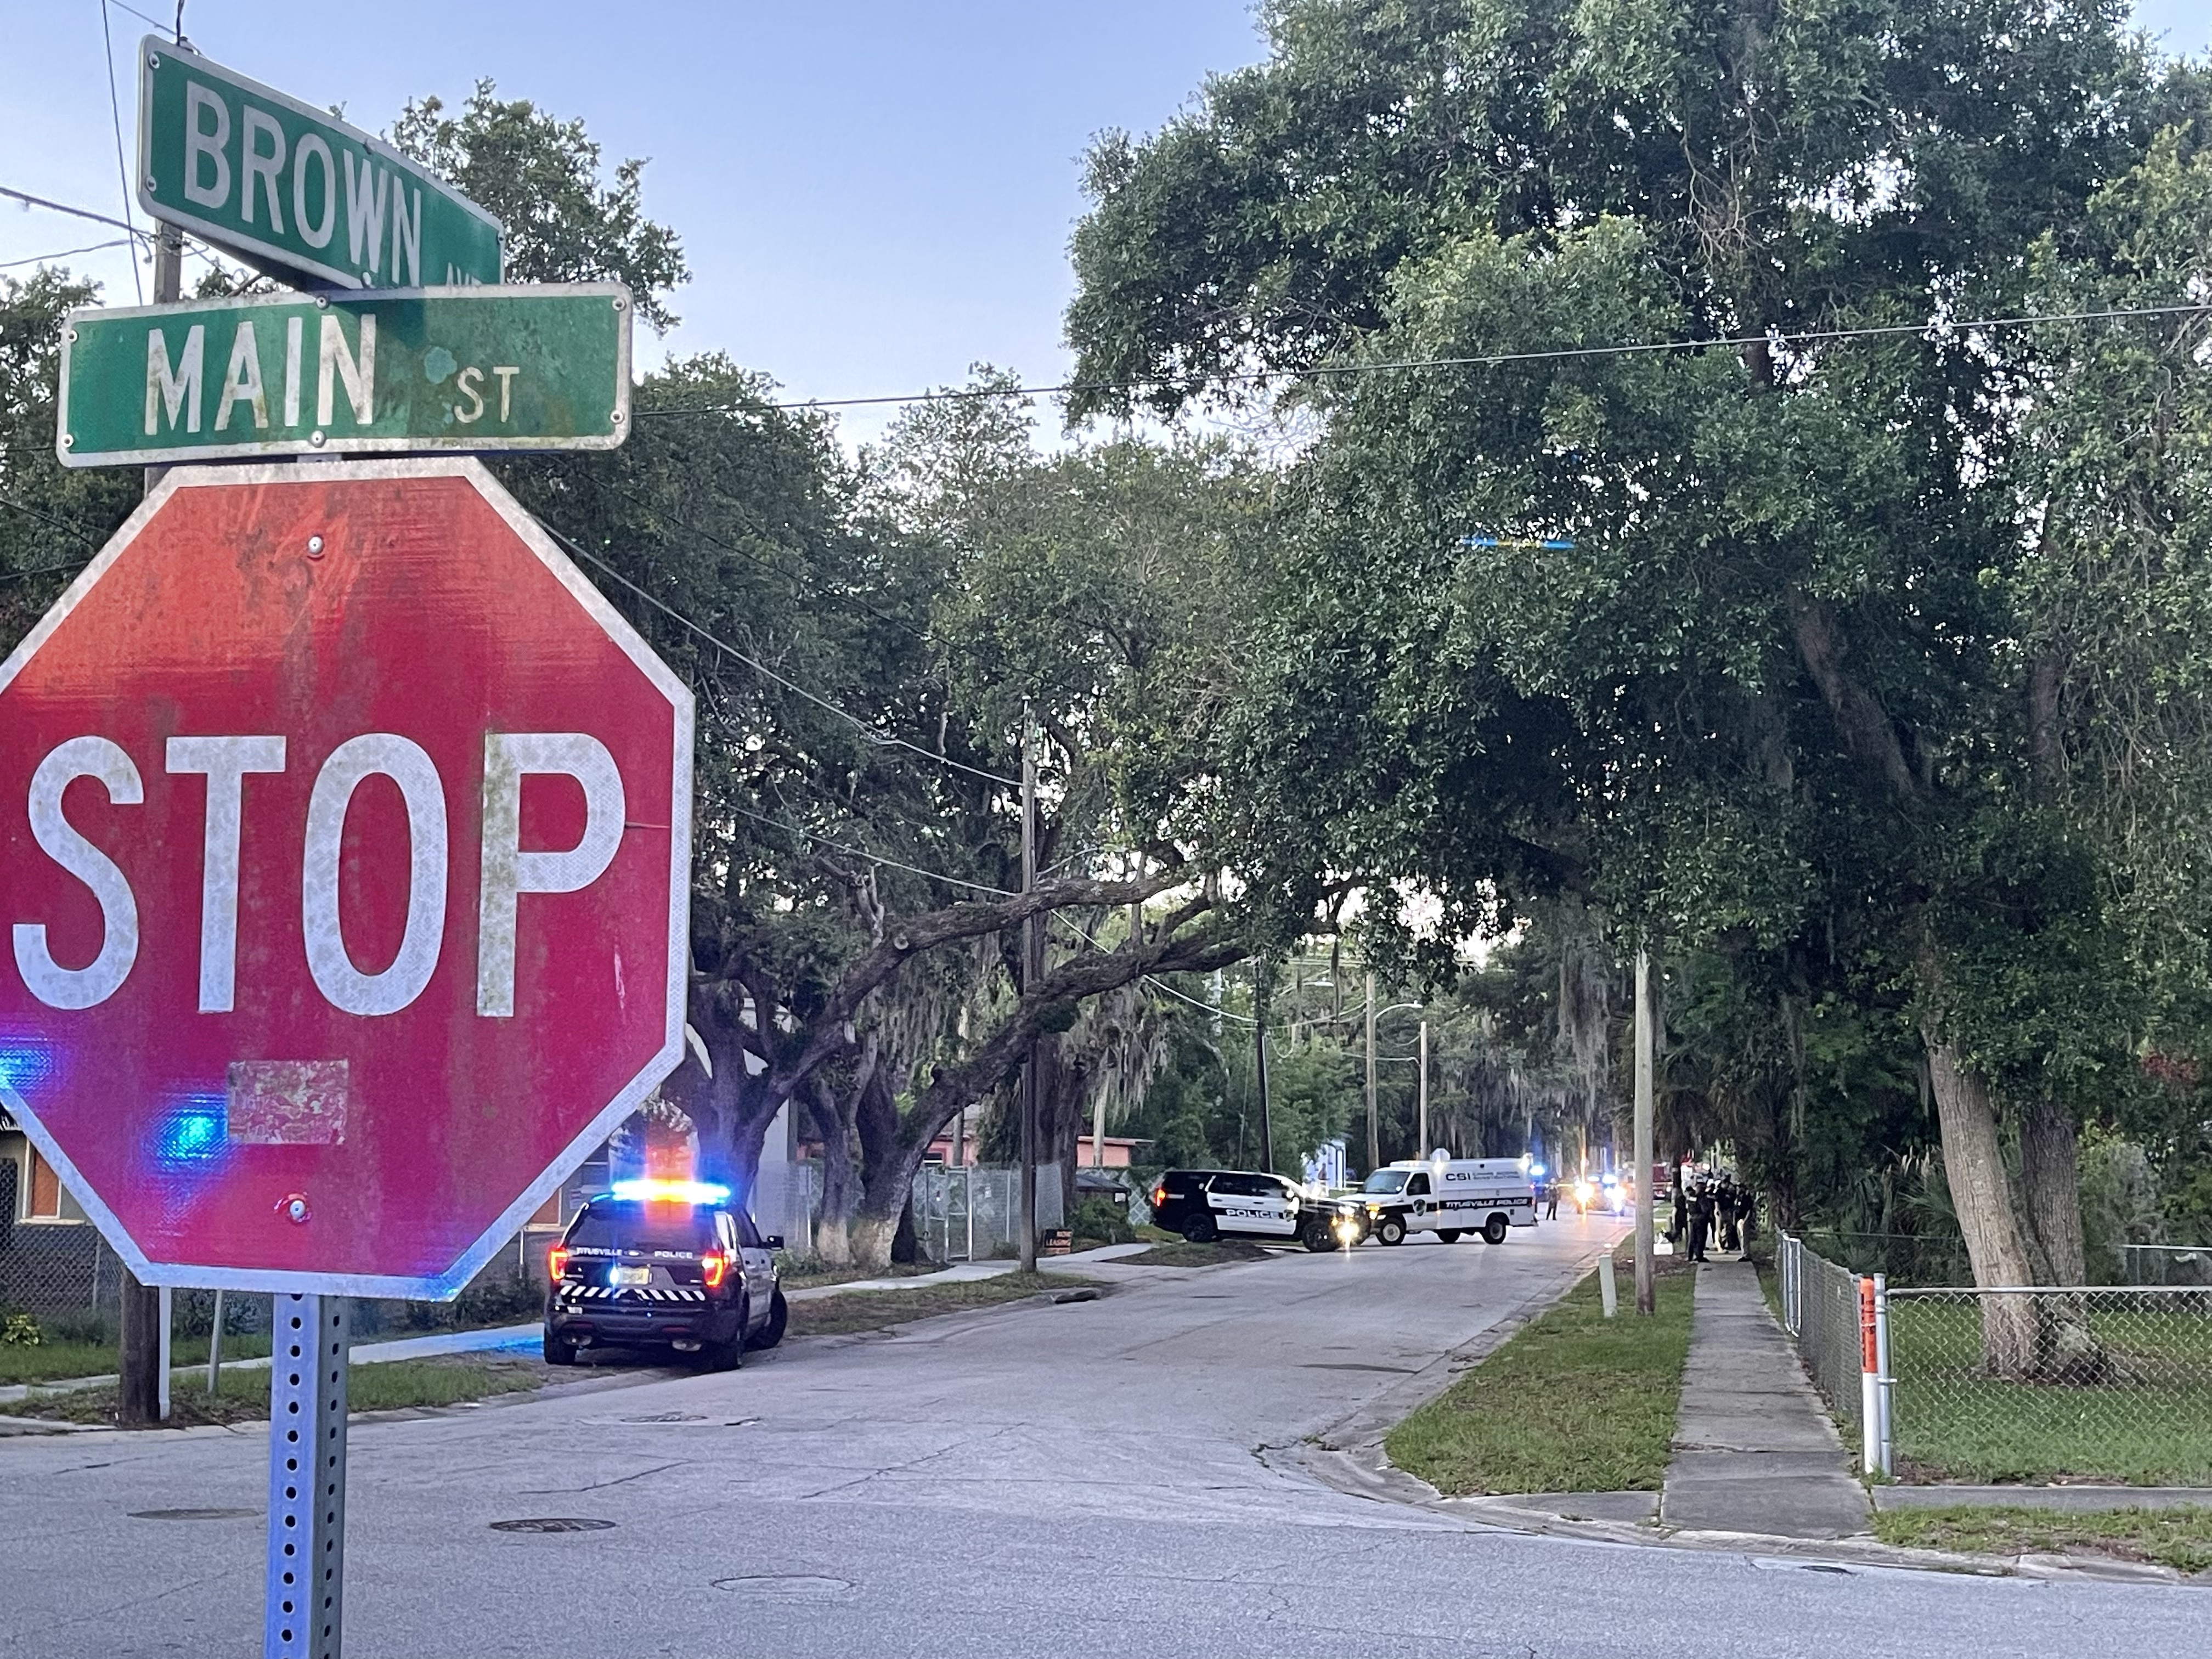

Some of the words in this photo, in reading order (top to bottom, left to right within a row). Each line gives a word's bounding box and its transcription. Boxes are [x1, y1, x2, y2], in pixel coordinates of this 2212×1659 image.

[184, 80, 420, 287] BROWN
[145, 314, 376, 435] MAIN
[454, 366, 520, 423] ST
[12, 733, 626, 1017] STOP
[1446, 1172, 1471, 1181] CSI
[1446, 1199, 1495, 1207] TITUSVILLE
[1226, 1209, 1280, 1219] POLICE
[577, 1247, 623, 1256] TITUSVILLE
[654, 1250, 693, 1259] POLICE
